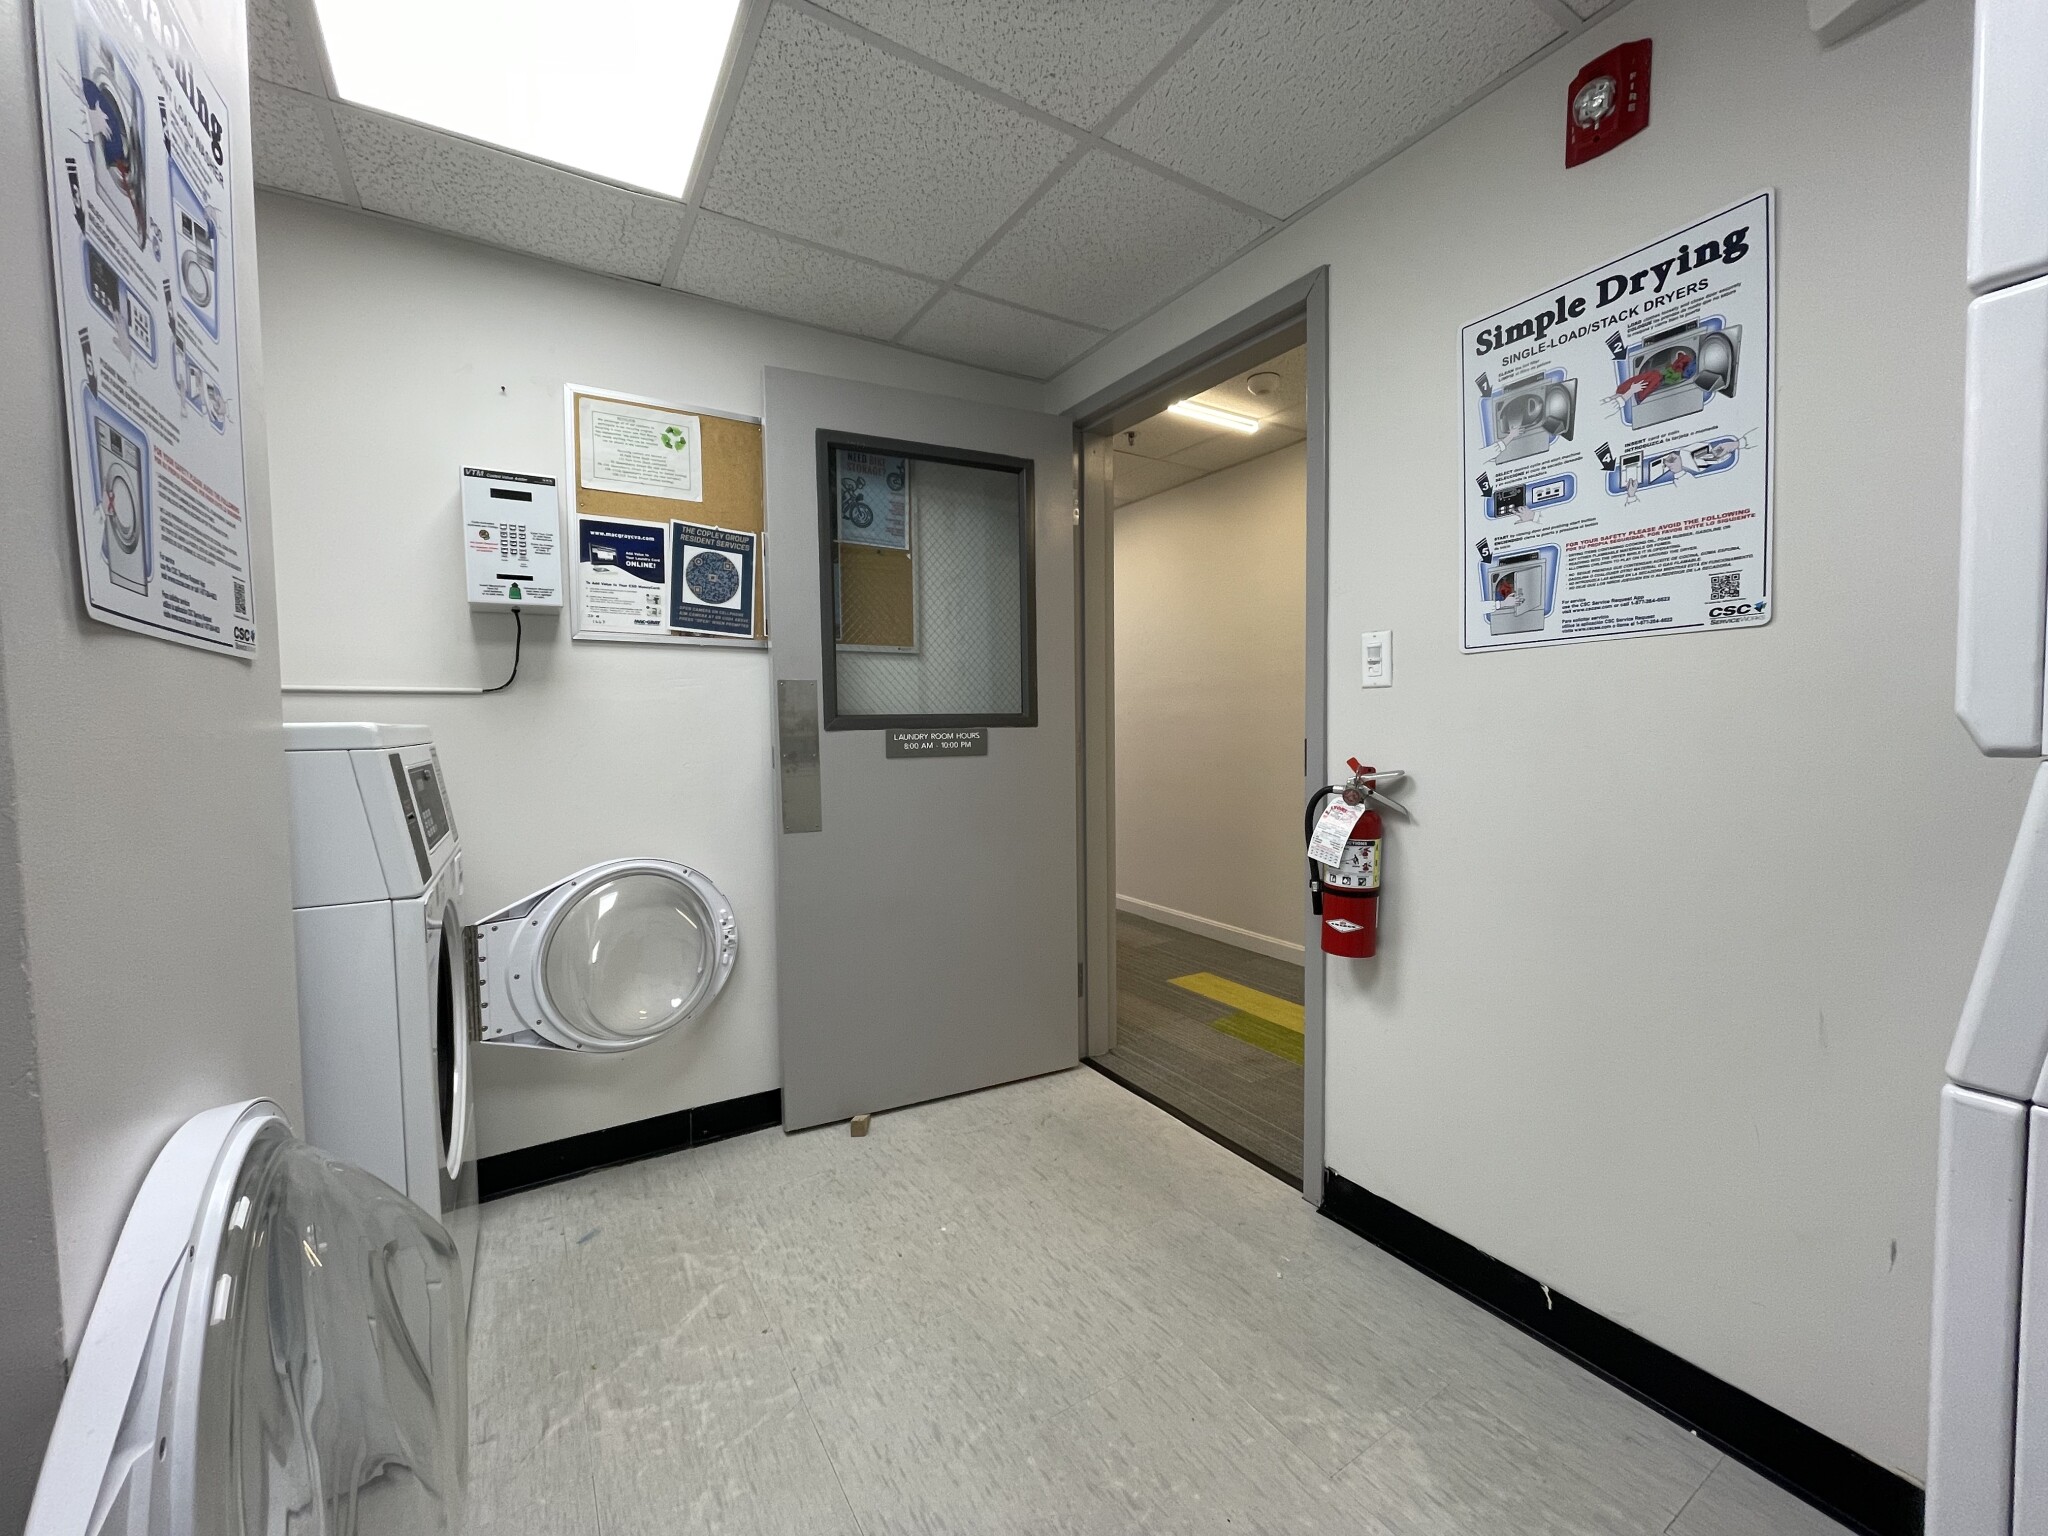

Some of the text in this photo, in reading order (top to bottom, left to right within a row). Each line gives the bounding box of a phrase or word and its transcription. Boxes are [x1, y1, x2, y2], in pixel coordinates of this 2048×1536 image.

[1476, 226, 1749, 356] Simple Drying
[1501, 278, 1709, 366] SINGLE-LOAD/STACK DRYERS
[1613, 341, 1624, 353] 2
[1482, 382, 1487, 391] 1
[848, 453, 867, 463] NEED
[1482, 482, 1489, 491] 3
[1581, 537, 1599, 545] YOUR
[1601, 532, 1627, 541] SAFETY
[1629, 526, 1656, 536] PLEASE
[1658, 521, 1681, 531] AVOID
[1684, 518, 1699, 526] THE
[1702, 508, 1750, 522] FOLLOWING
[1685, 522, 1704, 530] EVITE
[682, 526, 749, 543] THE COPLEY GROUP
[680, 534, 750, 551] RESIDENT SERVICES
[1481, 547, 1489, 557] 5
[626, 561, 656, 569] ONLINE!
[1709, 604, 1752, 618] CSC
[233, 626, 250, 642] CSC
[893, 733, 929, 741] LAUNDRY
[931, 732, 954, 740] ROOM
[941, 741, 959, 749] 10:00
